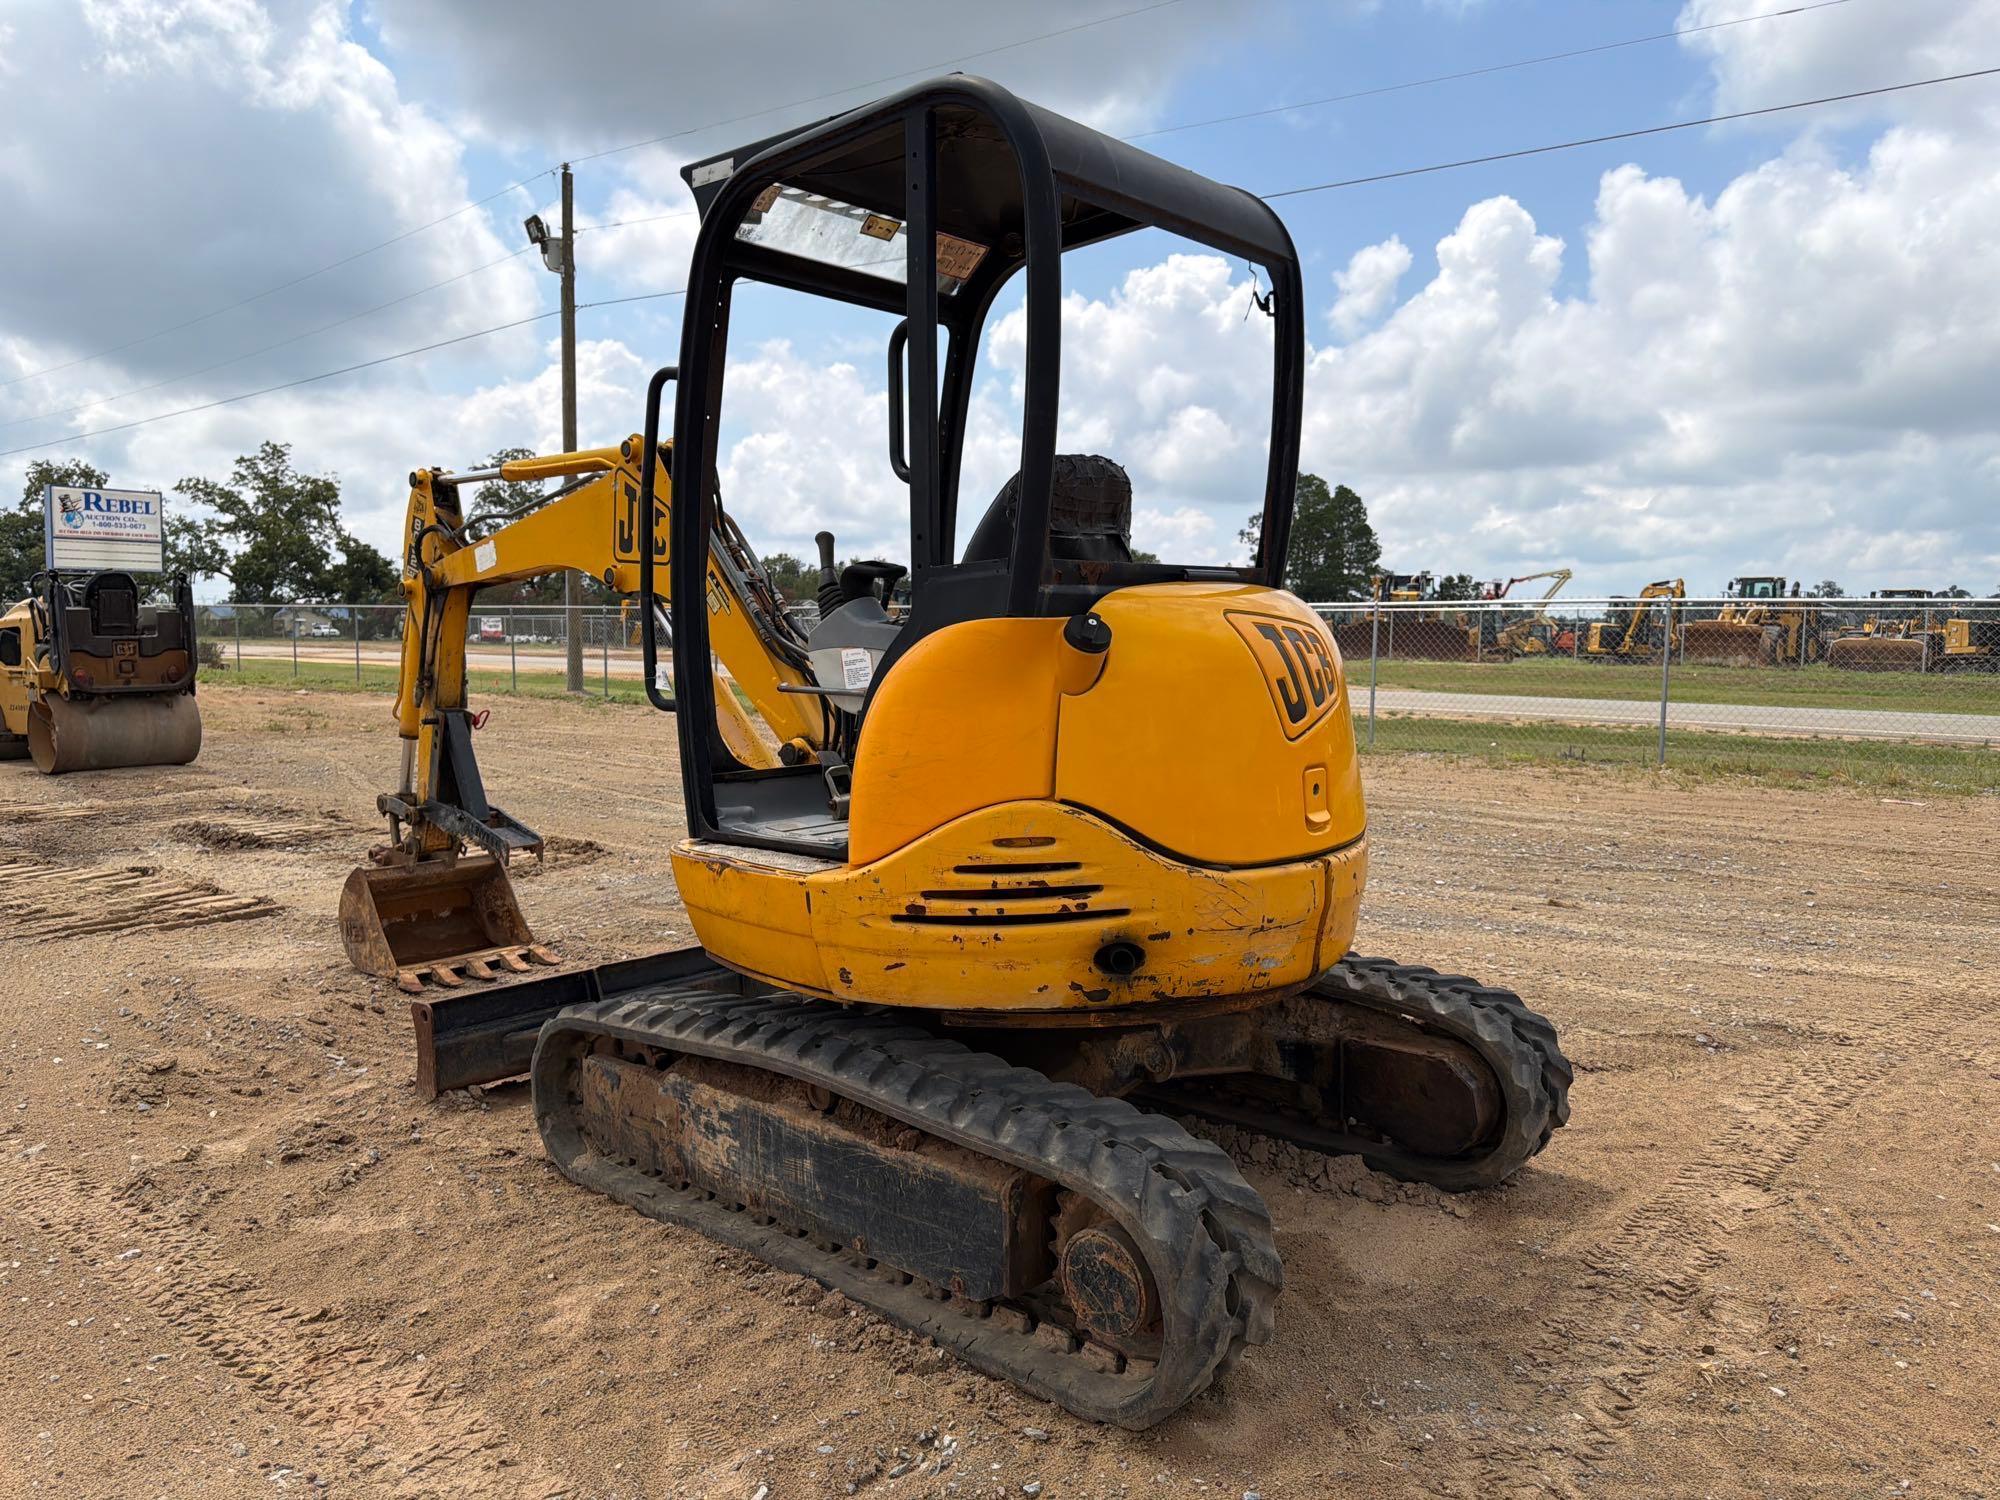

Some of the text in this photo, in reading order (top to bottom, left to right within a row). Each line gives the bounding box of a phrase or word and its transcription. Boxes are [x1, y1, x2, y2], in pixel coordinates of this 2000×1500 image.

[84, 514, 120, 522] AUCTION
[93, 521, 146, 529] 1-800-533-0673
[1252, 622, 1334, 724] JCB
